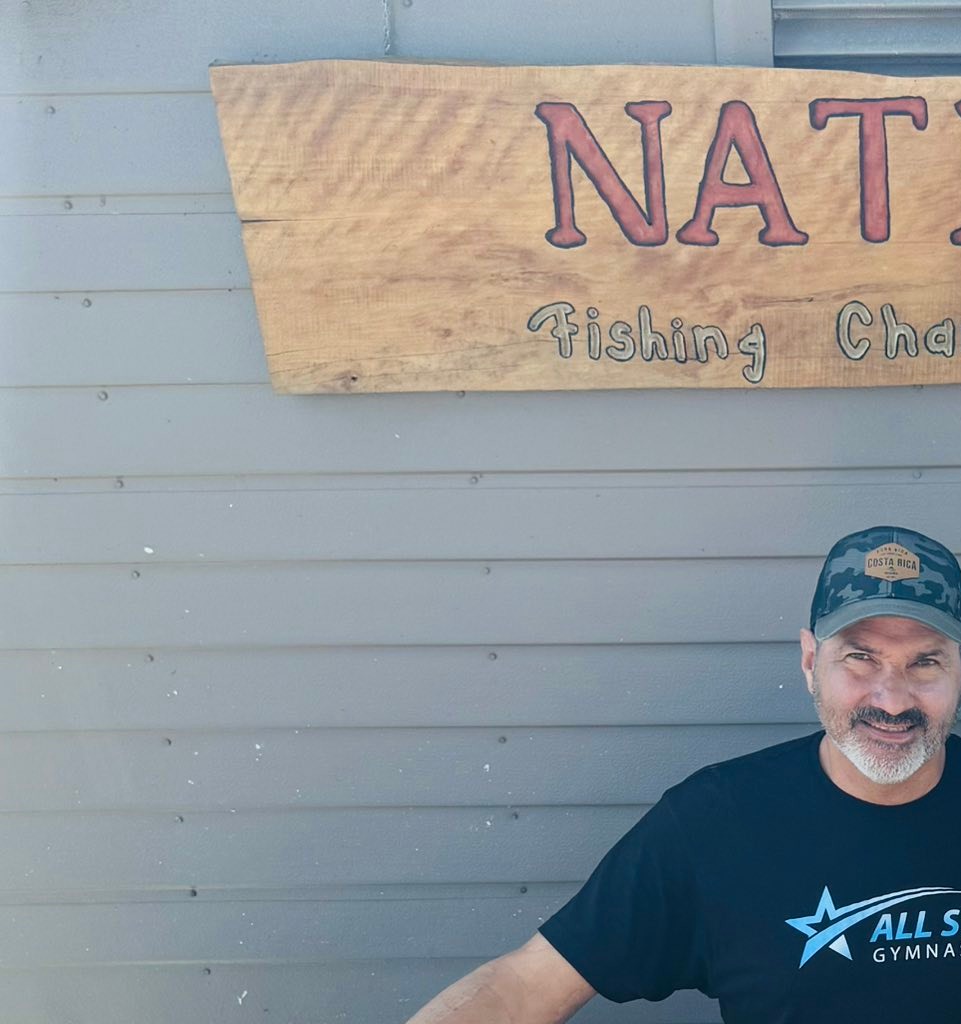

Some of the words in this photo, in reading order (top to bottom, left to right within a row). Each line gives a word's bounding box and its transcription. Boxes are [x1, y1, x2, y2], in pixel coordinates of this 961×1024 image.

[527, 302, 767, 384] Fishing
[867, 557, 894, 569] COSTA
[897, 558, 917, 571] RICA
[869, 910, 932, 943] ALL
